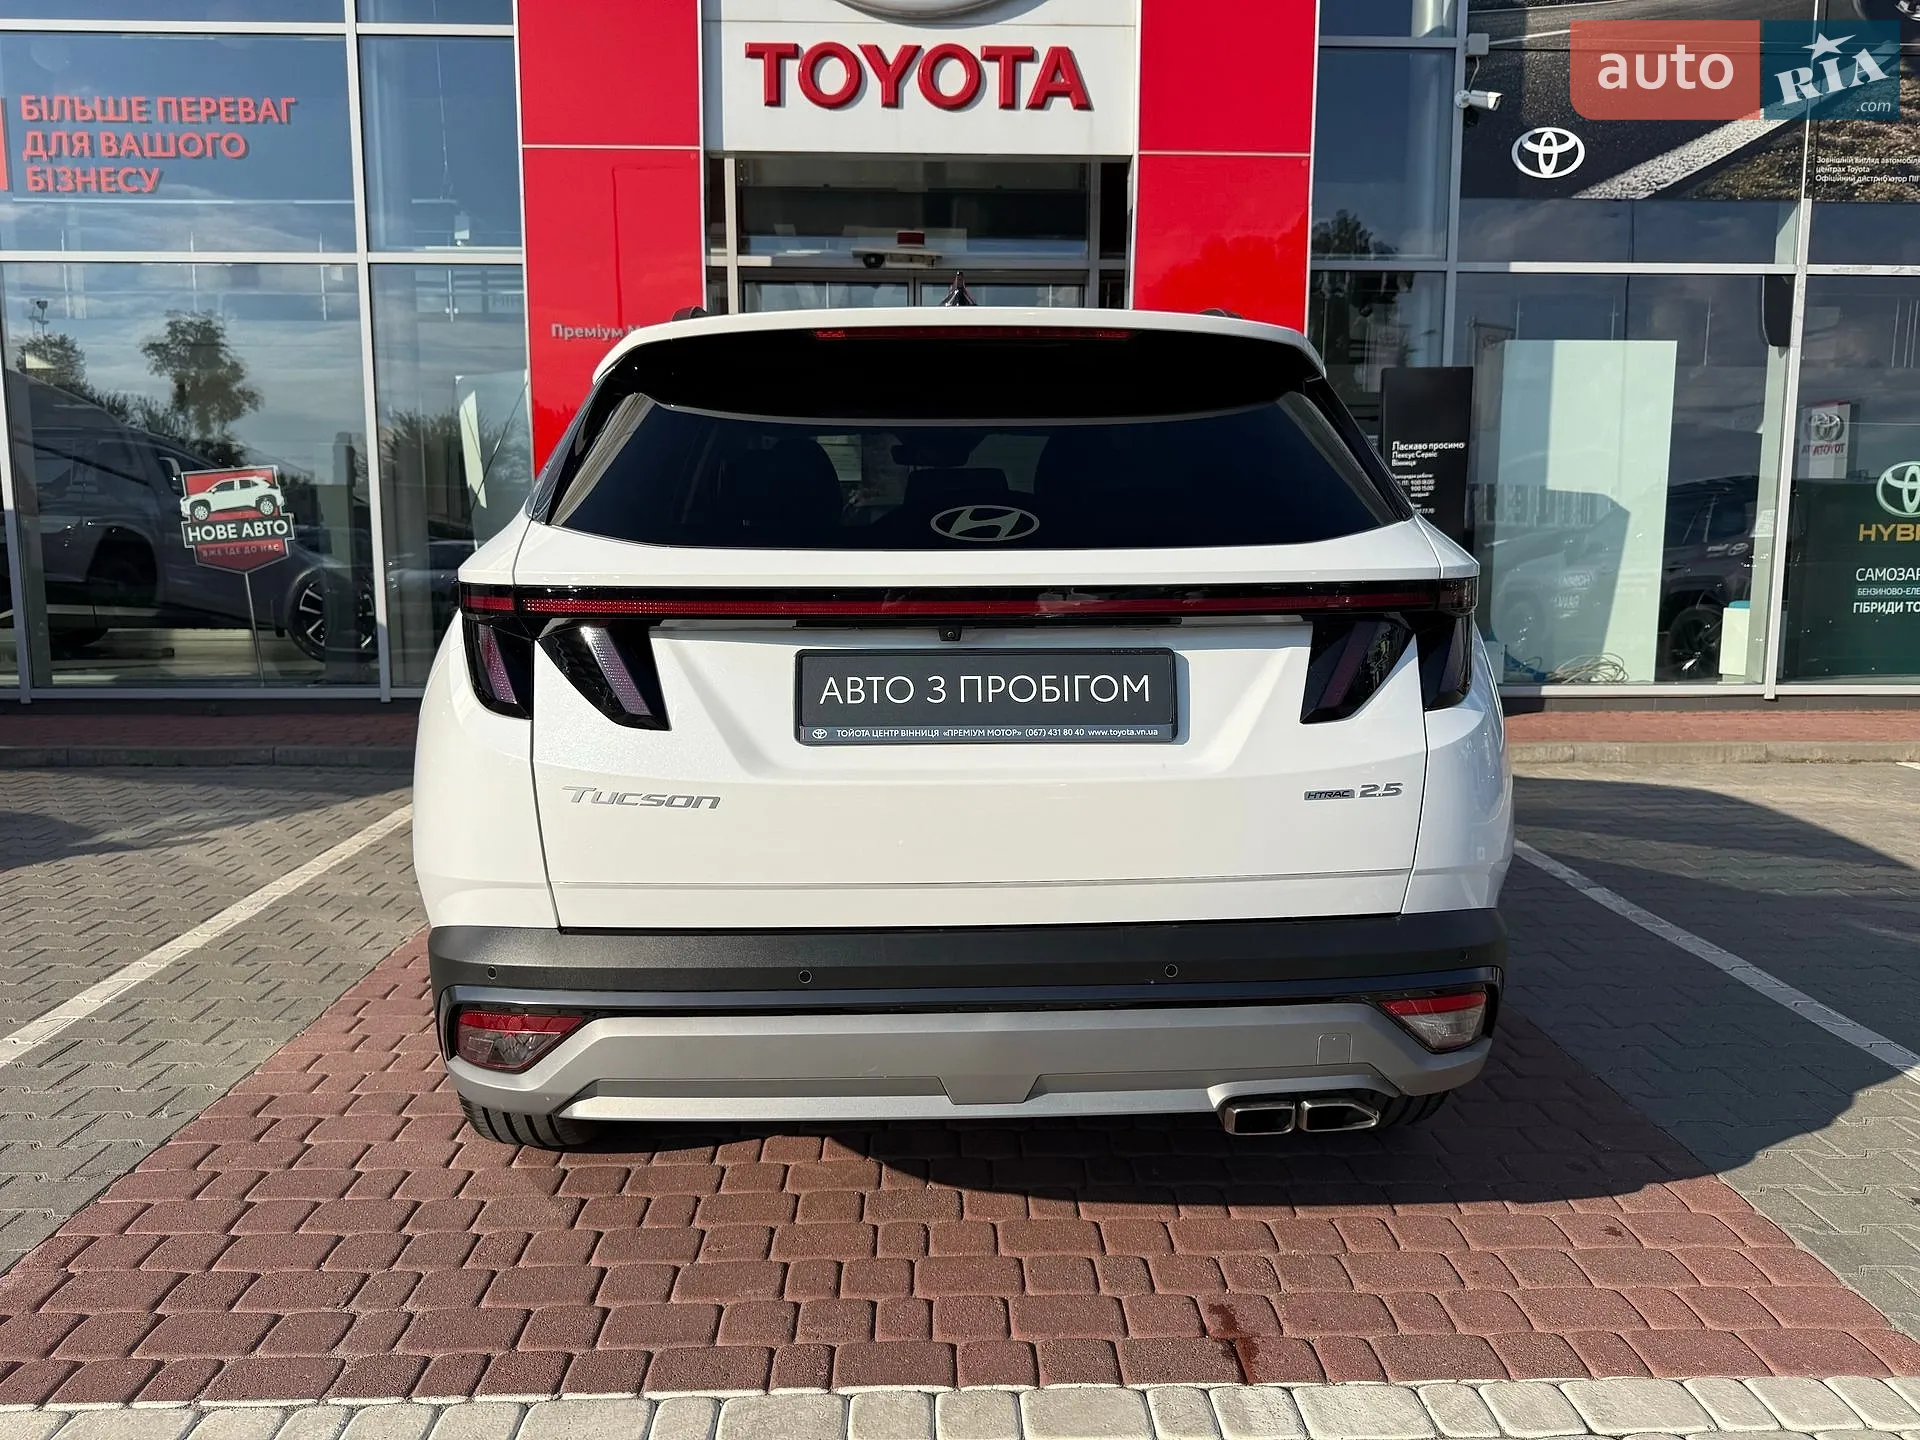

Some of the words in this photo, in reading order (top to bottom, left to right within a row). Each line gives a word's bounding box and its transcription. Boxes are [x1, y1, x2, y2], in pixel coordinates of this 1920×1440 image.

[745, 42, 1092, 111] TOYOTA
[20, 95, 148, 121] БІЛЬШЕ
[157, 96, 296, 123] ПЕРЕВАГ
[22, 131, 90, 161] ДЛЯ
[101, 132, 247, 159] ВАШОГО
[1815, 165, 1846, 173] центрах
[1847, 166, 1870, 174] Toyota
[26, 166, 160, 193] БІЗНЕСУ
[1815, 174, 1855, 183] Офіційний
[551, 324, 623, 341] Преміум
[1392, 441, 1428, 451] Ласкаво
[1429, 442, 1465, 451] просимо
[187, 523, 238, 542] НОВЕ
[242, 520, 289, 538] АВТО
[1859, 523, 1920, 541] HYB
[244, 545, 258, 554] ДО
[1853, 601, 1904, 614] ГІБРИДИ
[819, 676, 915, 705] АВТО
[926, 676, 947, 703] З
[960, 674, 1150, 703] ПРОБІГОМ
[837, 728, 871, 737] ТОЙОТА
[872, 729, 899, 739] ЦЕНТР
[900, 729, 939, 739] ВІННИЦЯ
[942, 729, 985, 737] «ПРЕМІУМ
[987, 729, 1022, 737] МОТОР»
[1025, 728, 1046, 738] (067)
[1048, 728, 1061, 736] 431
[1063, 728, 1073, 736] 80
[1074, 728, 1085, 736] 40
[1088, 728, 1158, 738] www.toyota.vn.ua
[1307, 790, 1350, 799] HTRAC
[1359, 783, 1403, 798] 2.5
